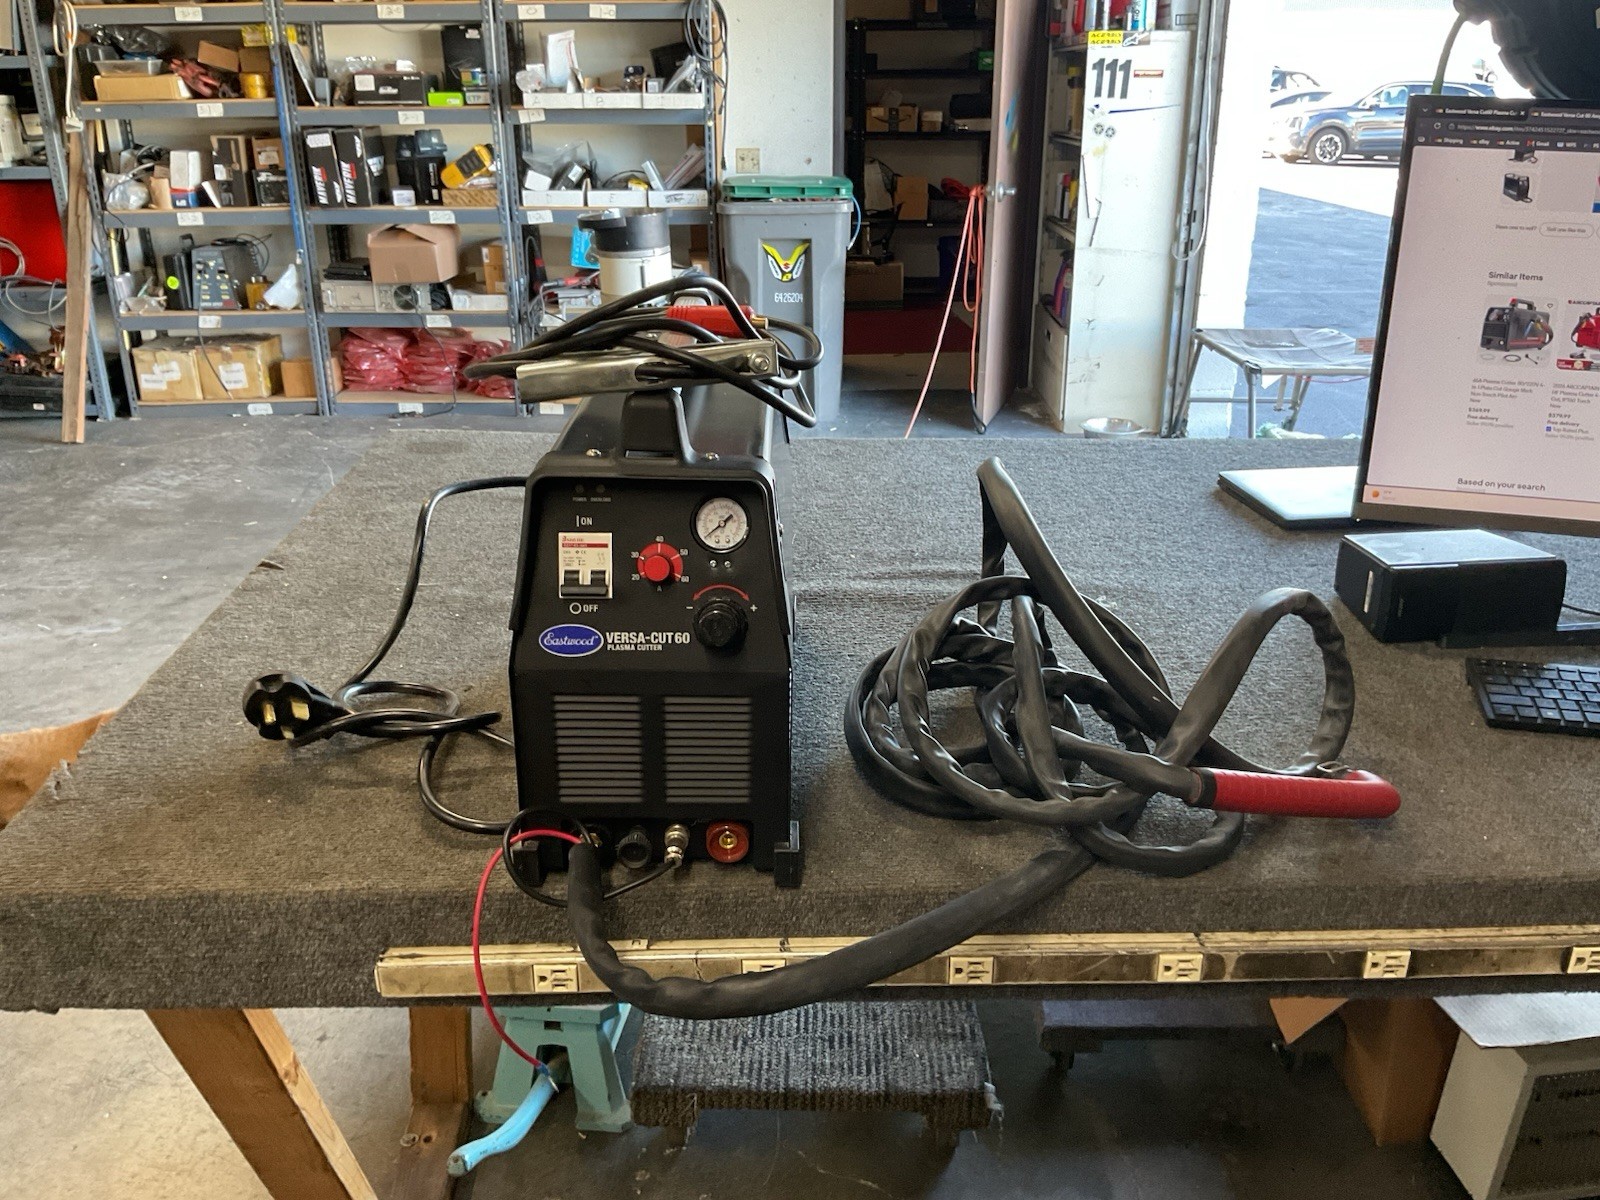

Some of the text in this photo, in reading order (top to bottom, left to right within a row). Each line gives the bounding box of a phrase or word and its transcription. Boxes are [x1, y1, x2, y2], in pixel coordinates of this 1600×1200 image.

[1091, 57, 1133, 100] 111
[1488, 271, 1544, 281] Similar Items
[1457, 477, 1546, 491] Based on your search
[580, 516, 593, 526] ON
[630, 551, 640, 559] 30
[680, 548, 689, 556] 50
[631, 573, 640, 581] 20
[680, 575, 690, 583] 60
[582, 604, 599, 613] OFF
[543, 632, 595, 646] Eastwood
